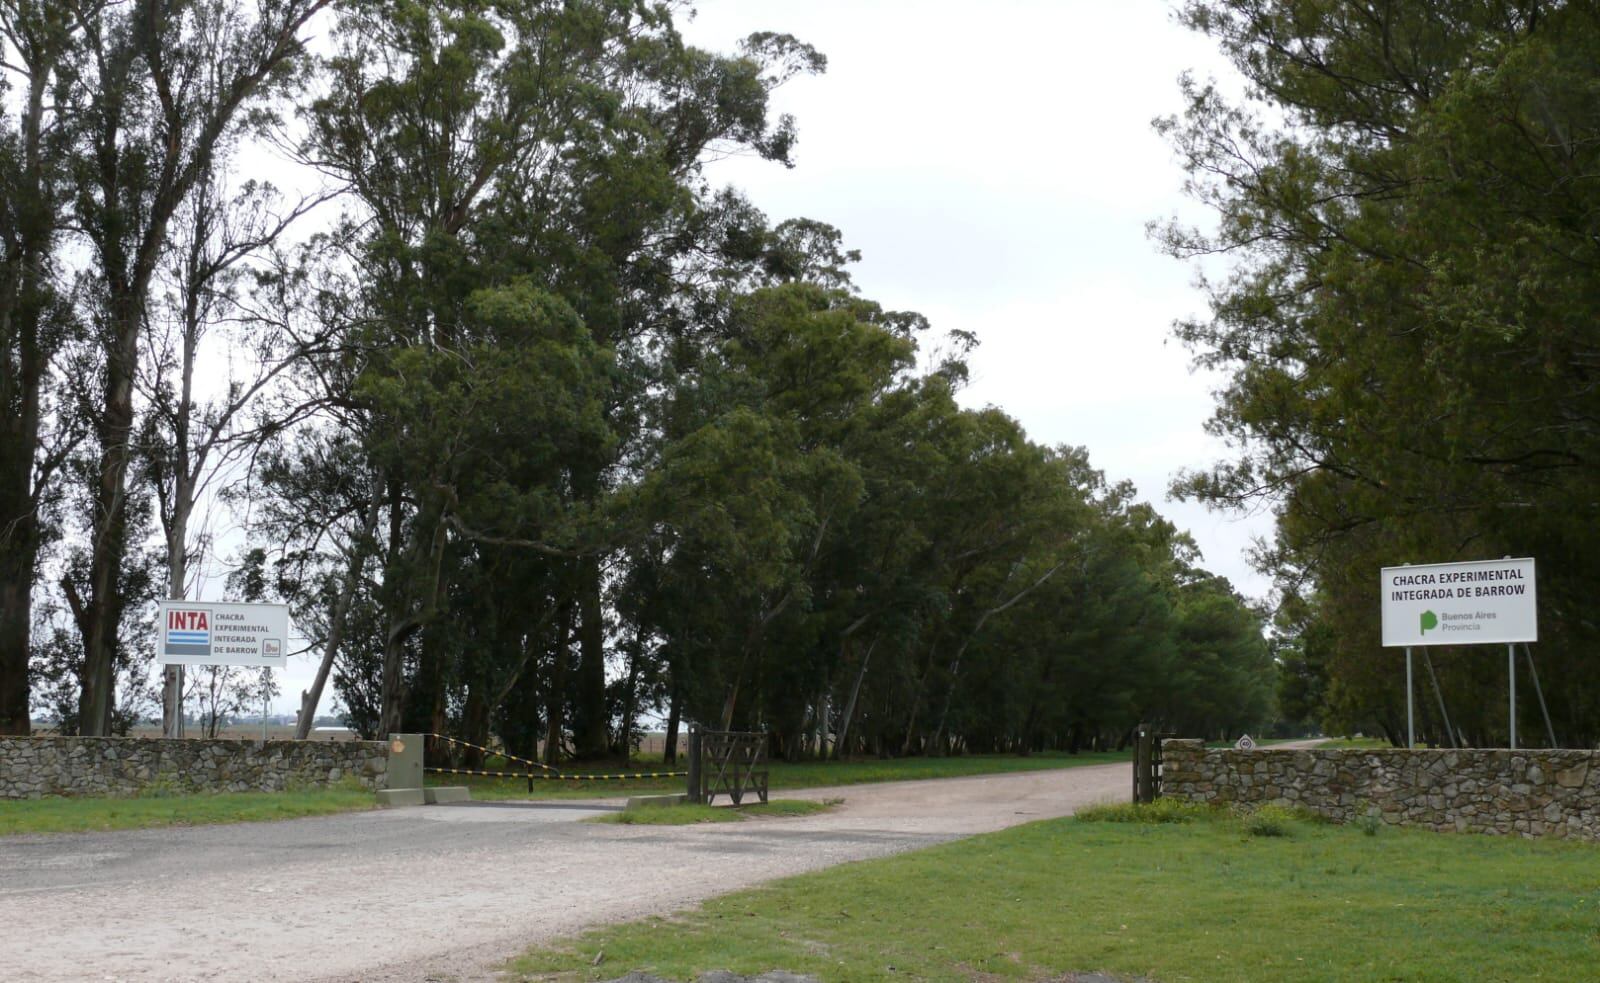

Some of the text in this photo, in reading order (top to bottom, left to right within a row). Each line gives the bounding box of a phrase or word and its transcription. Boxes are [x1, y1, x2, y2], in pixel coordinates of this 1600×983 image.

[1393, 569, 1524, 586] CHACRA EXPERIMENTAL
[1392, 584, 1525, 601] INTEGRADA DE BARROW
[168, 612, 208, 630] INTA
[1442, 611, 1496, 621] Buenos Aires
[215, 624, 270, 632] EXPERIMENTAL
[1442, 623, 1480, 632] Provincia
